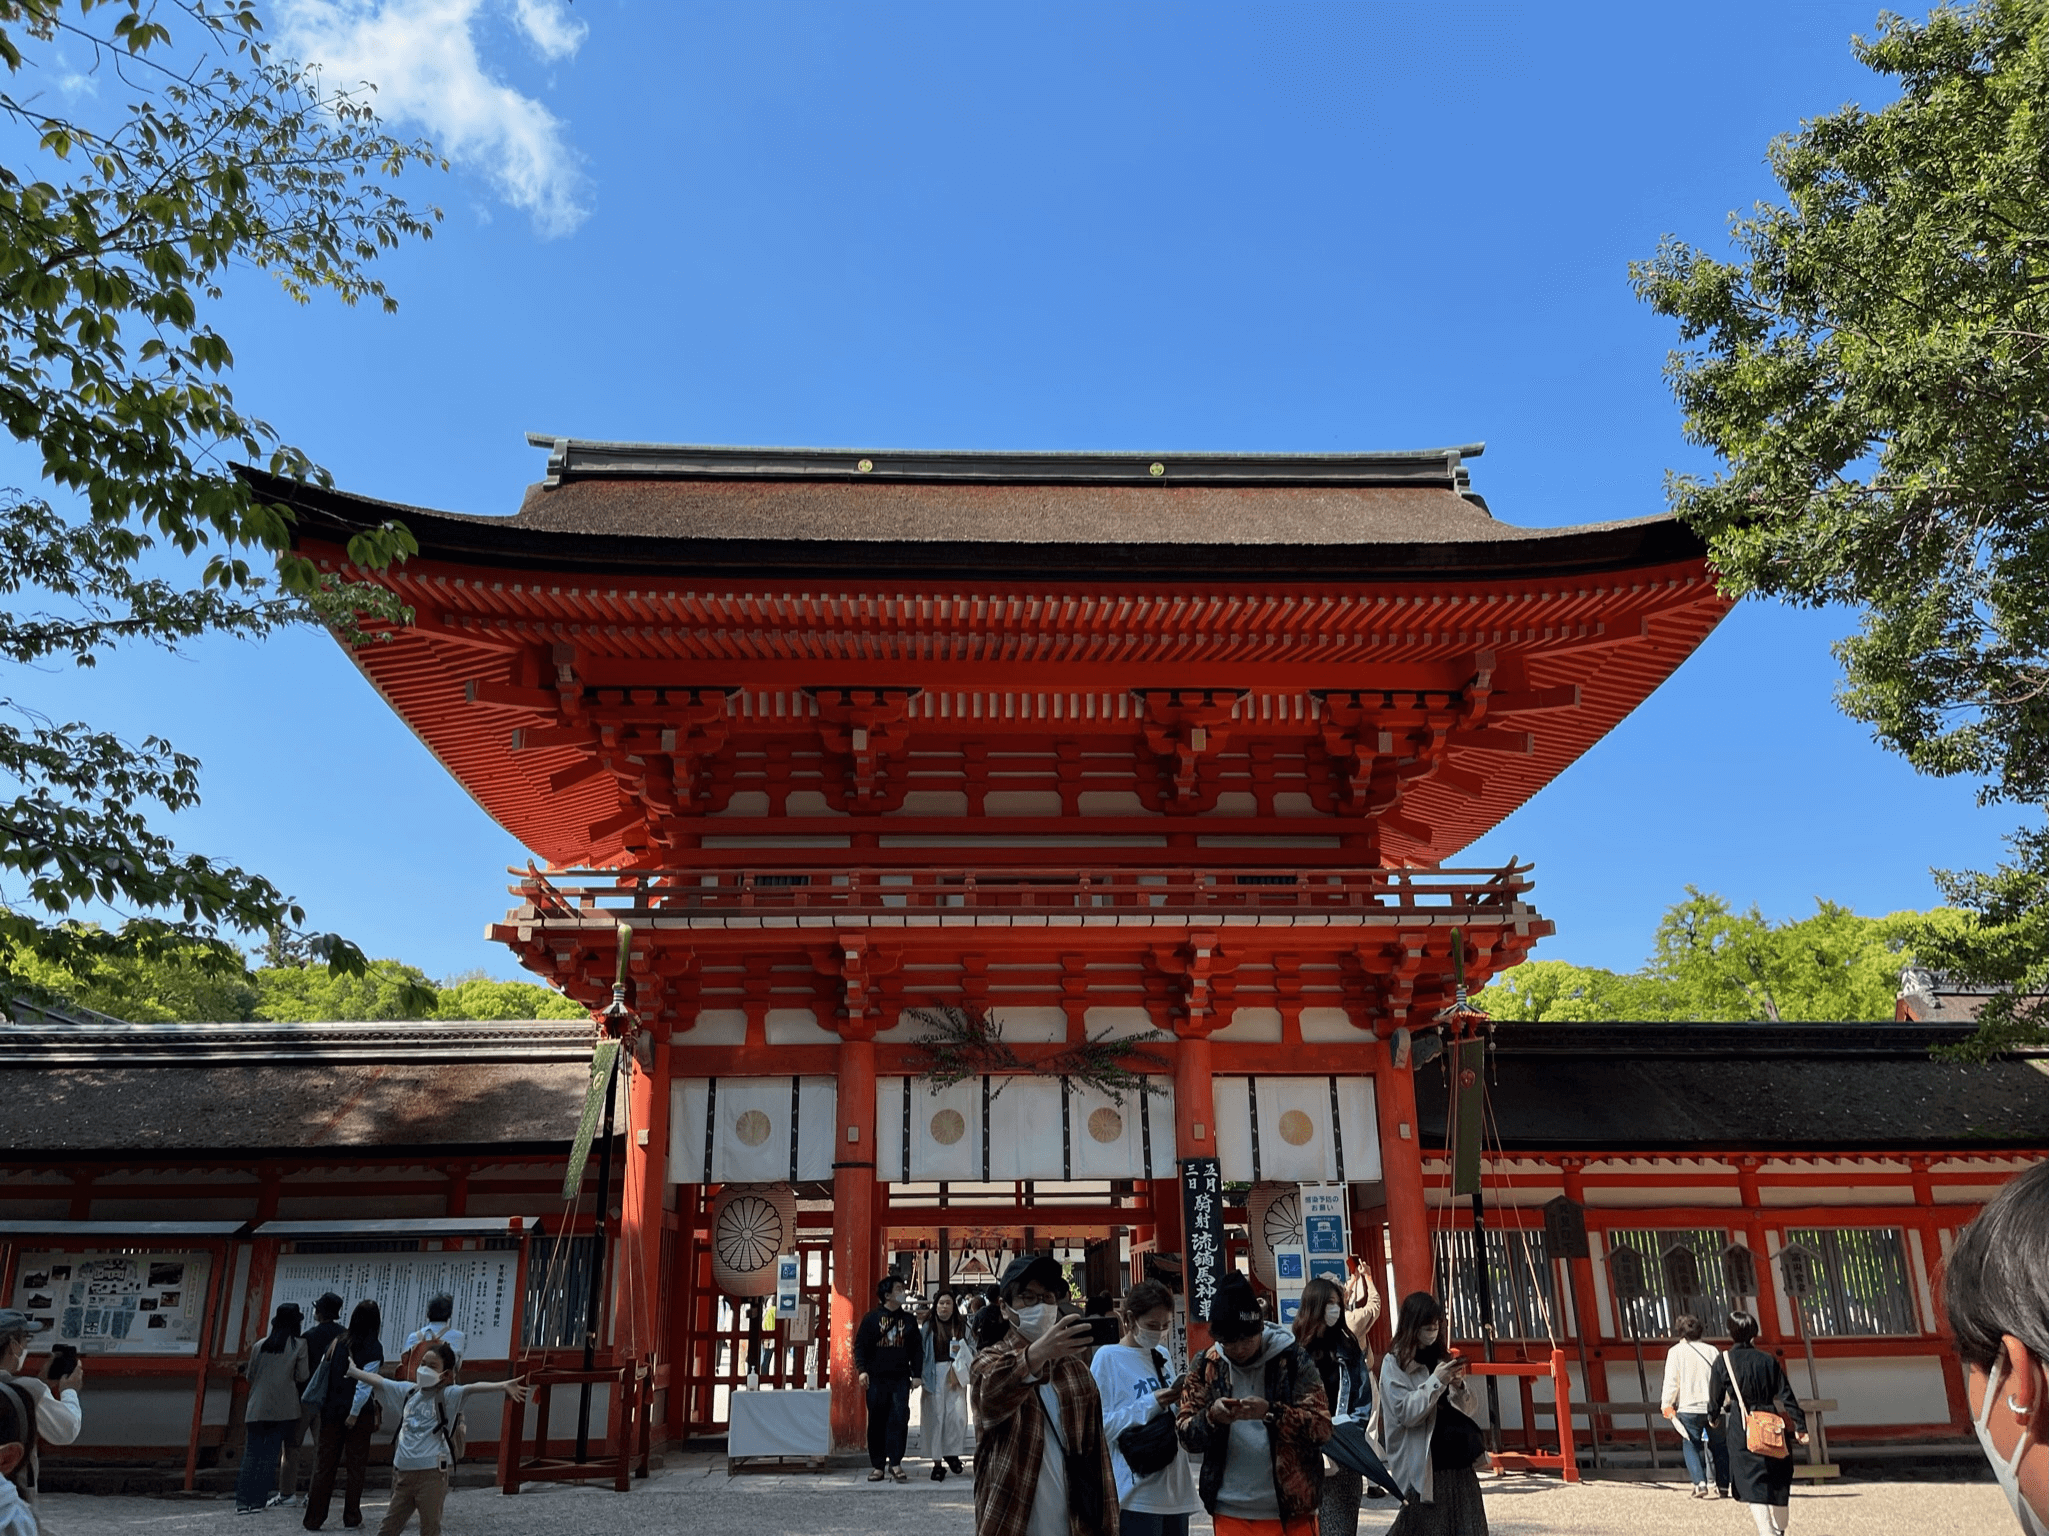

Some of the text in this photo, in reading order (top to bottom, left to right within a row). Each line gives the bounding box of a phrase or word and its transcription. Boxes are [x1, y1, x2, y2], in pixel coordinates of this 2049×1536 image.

[1185, 1164, 1199, 1189] 三日
[1203, 1163, 1218, 1192] 五月
[1305, 1195, 1339, 1203] 感染予防の
